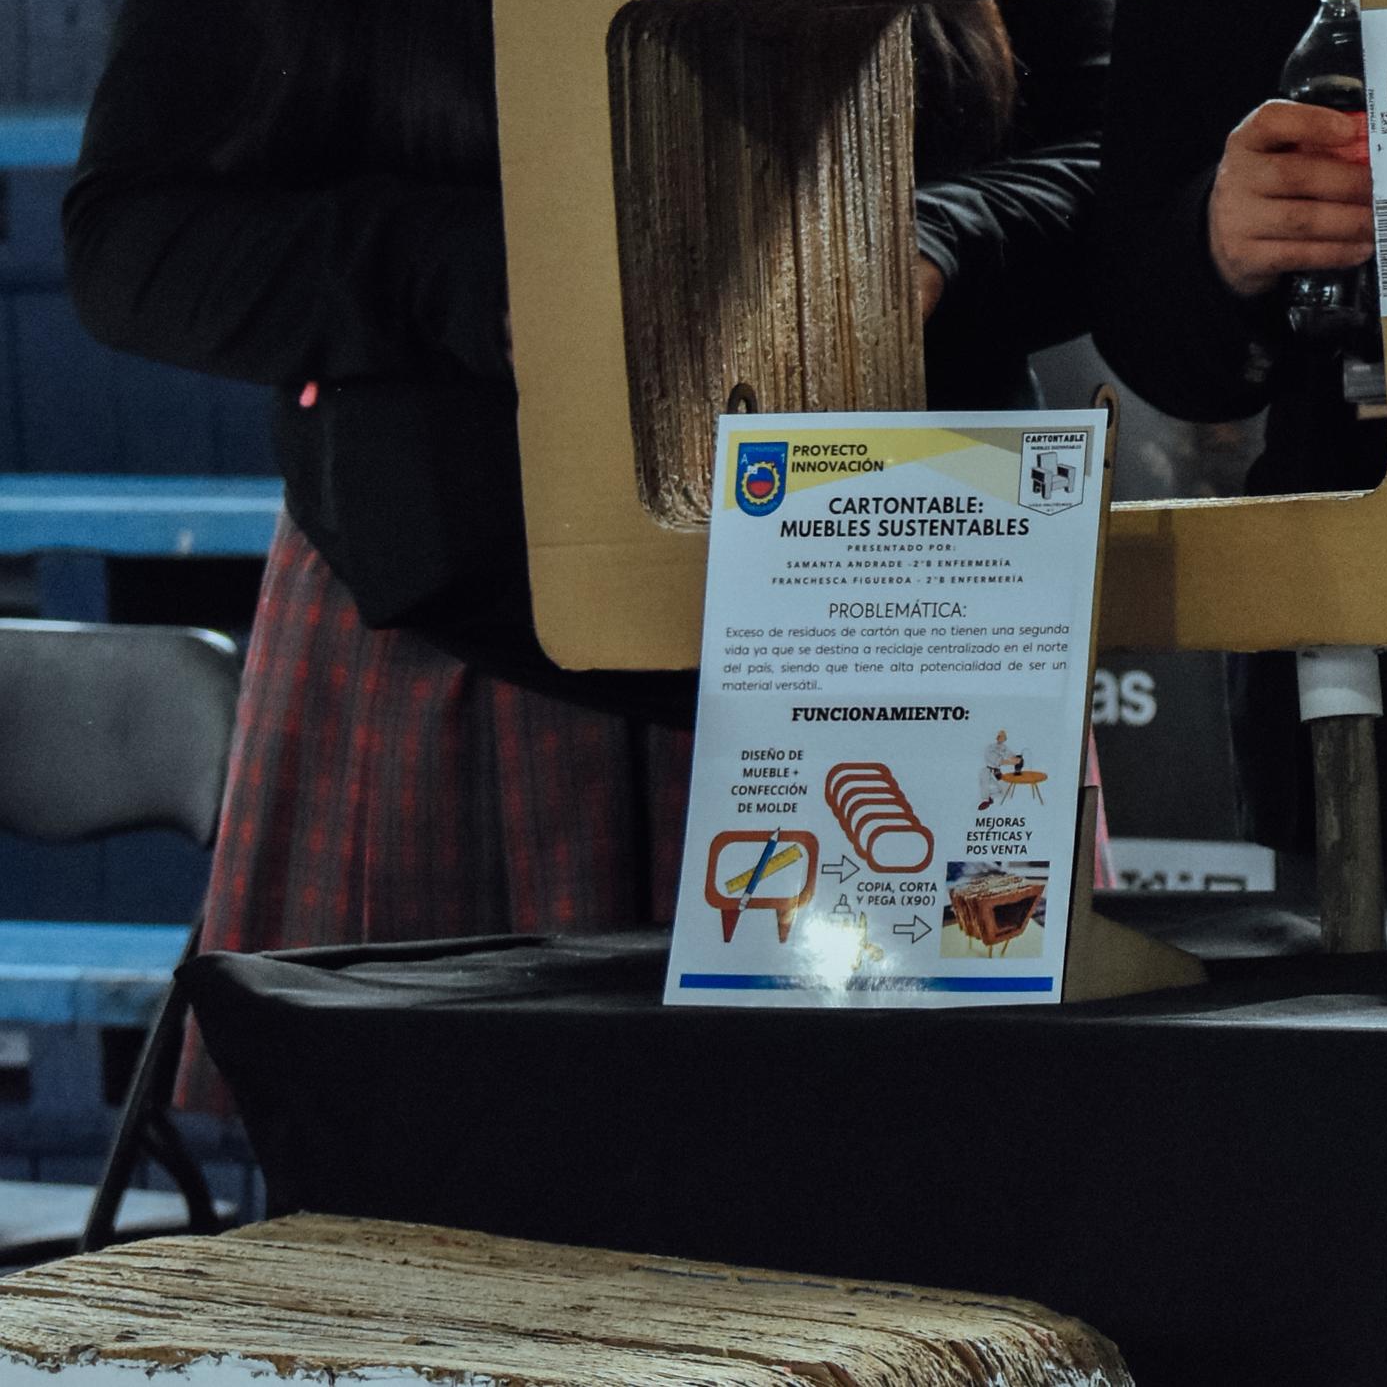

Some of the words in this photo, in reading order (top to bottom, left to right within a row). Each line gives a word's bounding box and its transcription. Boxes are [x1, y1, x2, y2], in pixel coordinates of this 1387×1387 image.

[1024, 433, 1085, 444] CARTONTABLE
[792, 443, 868, 457] PROYECTO
[791, 457, 885, 473] INNOVACIÓN
[828, 496, 984, 515] CARTONTABLE:
[780, 519, 871, 538] MUEBLES
[877, 517, 1030, 537] SUSTENTABLES
[847, 543, 924, 553] PRESENTADO
[829, 600, 967, 619] PROBLEMÁTICA:
[725, 626, 765, 639] Exceso
[768, 626, 784, 638] de
[787, 626, 837, 638] residuos
[840, 626, 857, 638] de
[860, 625, 900, 638] cartón
[903, 627, 927, 638] que
[930, 627, 947, 637] no
[950, 625, 988, 637] tienen
[991, 626, 1015, 636] una
[1018, 623, 1070, 638] segunda
[791, 705, 970, 722] FUNCIONAMIENTO:
[740, 747, 786, 761] DISEÑO
[788, 749, 804, 761] DE
[742, 767, 790, 779] MUEBLE
[730, 782, 808, 796] CONFECCIÓN
[737, 802, 753, 814] DE
[755, 802, 798, 814] MOLDE
[975, 816, 1026, 831] MEJORAS
[966, 829, 1023, 842] ESTÉTICAS
[1025, 830, 1033, 841] Y
[965, 844, 988, 855] POS
[990, 844, 1028, 855] VENTA
[856, 881, 895, 894] COPIA,
[898, 881, 938, 893] CORTA
[856, 895, 864, 905] Y
[867, 894, 897, 906] PEGA
[900, 894, 936, 907] (X90)
